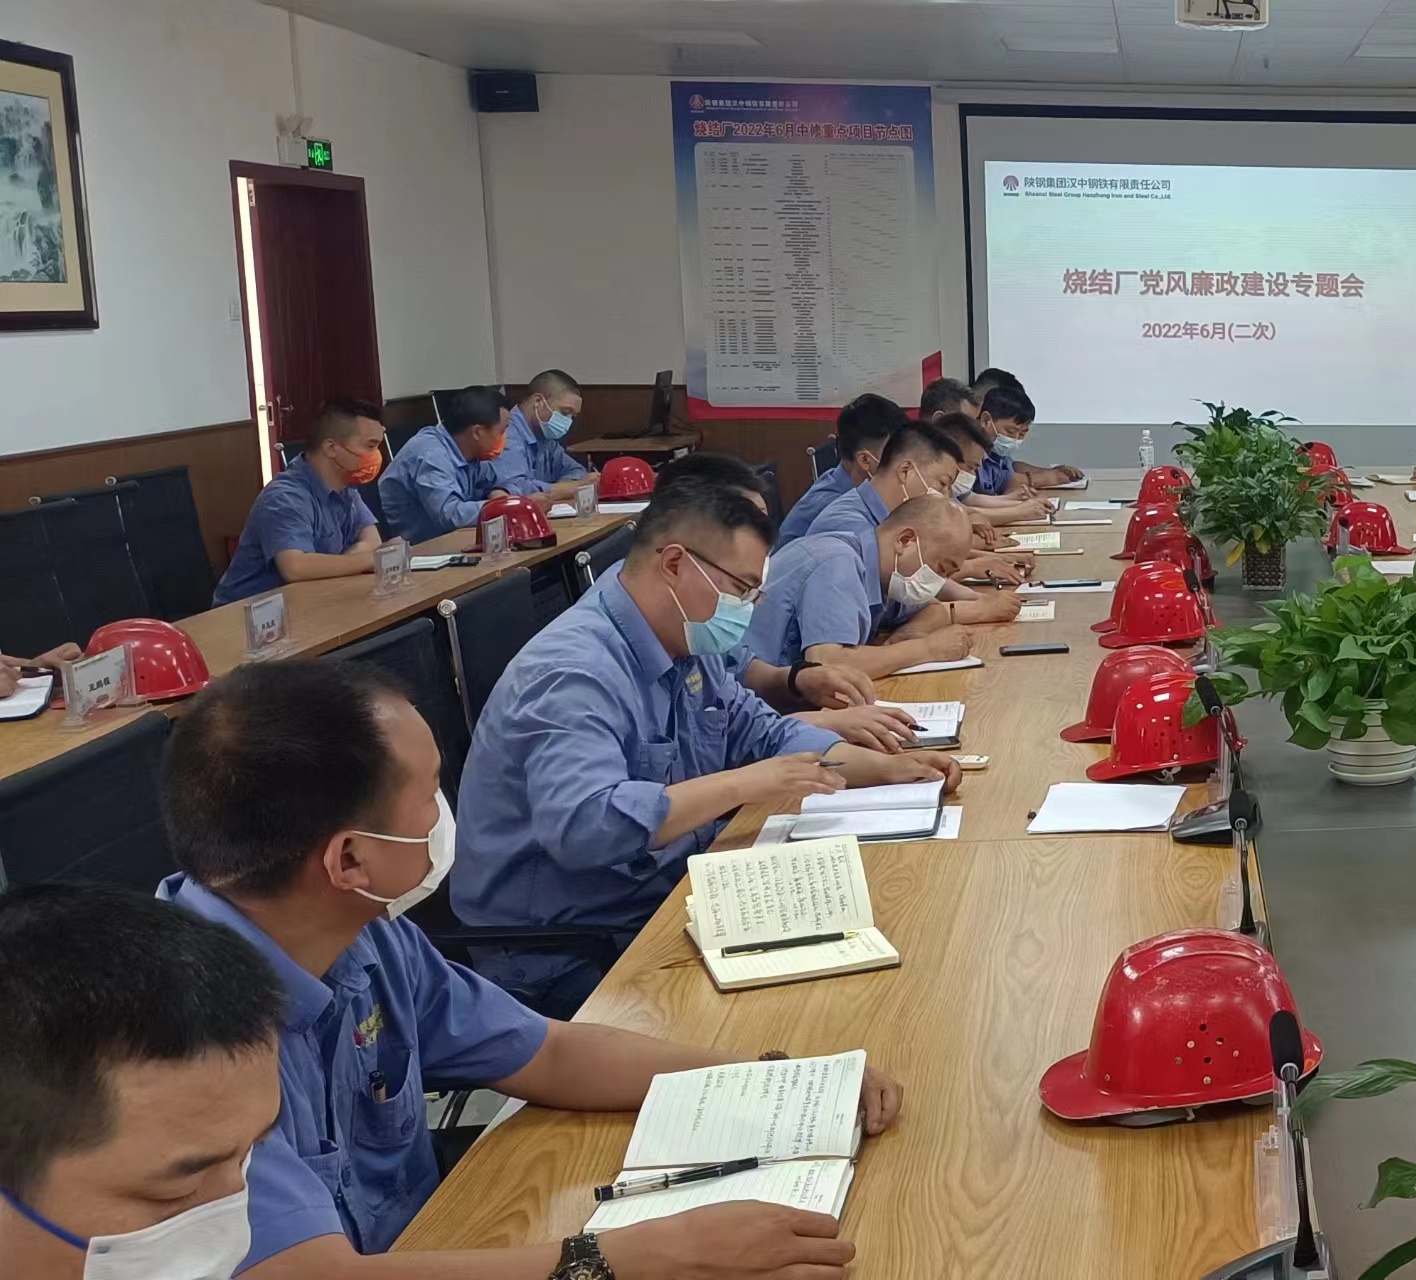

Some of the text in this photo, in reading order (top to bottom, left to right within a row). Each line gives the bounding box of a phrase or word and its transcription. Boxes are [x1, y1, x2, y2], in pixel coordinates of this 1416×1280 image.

[1024, 177, 1171, 191] 陕钢集团汉中钢铁有限责任公司
[1062, 268, 1365, 298] 烧结厂党风廉政建设专题会
